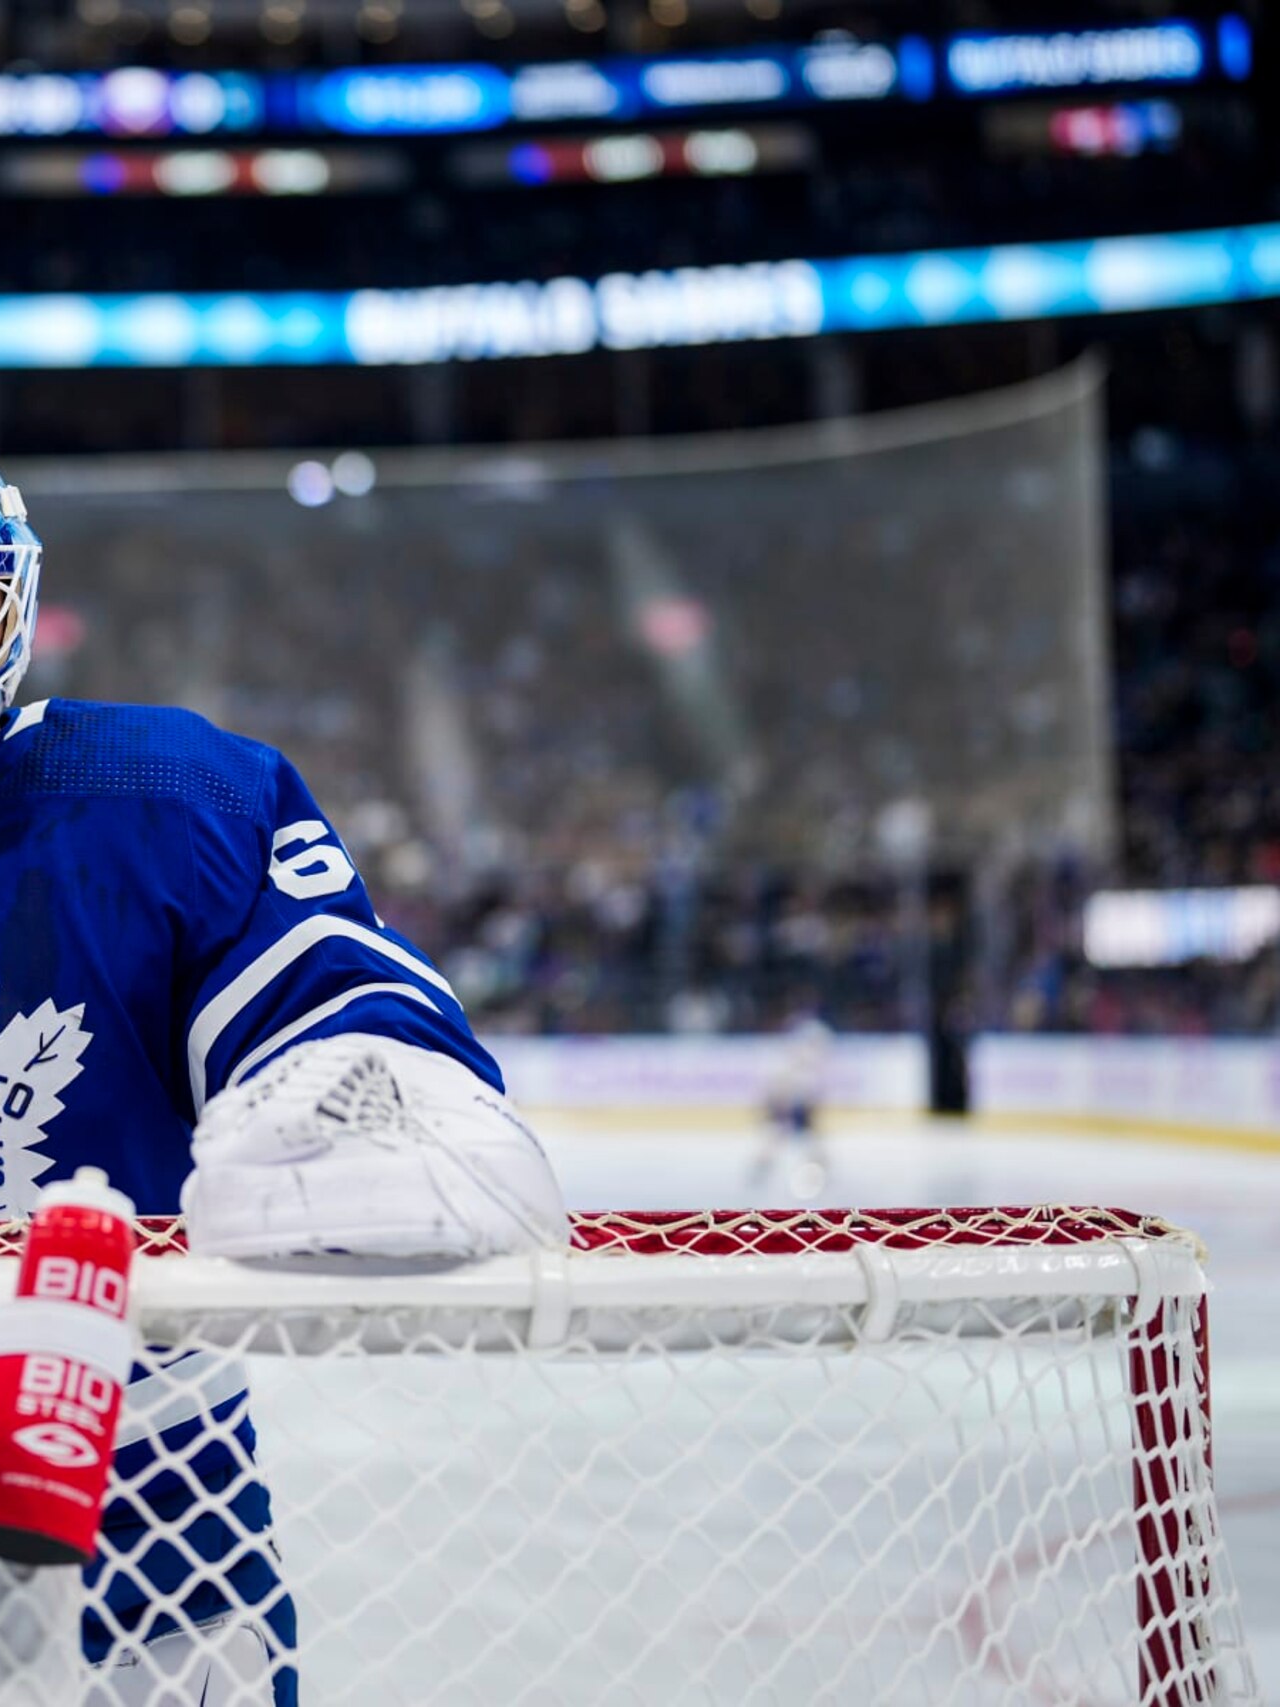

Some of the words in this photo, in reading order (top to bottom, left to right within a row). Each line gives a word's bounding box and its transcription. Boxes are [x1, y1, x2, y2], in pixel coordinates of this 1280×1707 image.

[268, 820, 383, 928] 6
[34, 1255, 125, 1316] BIO
[20, 1355, 114, 1415] BIO
